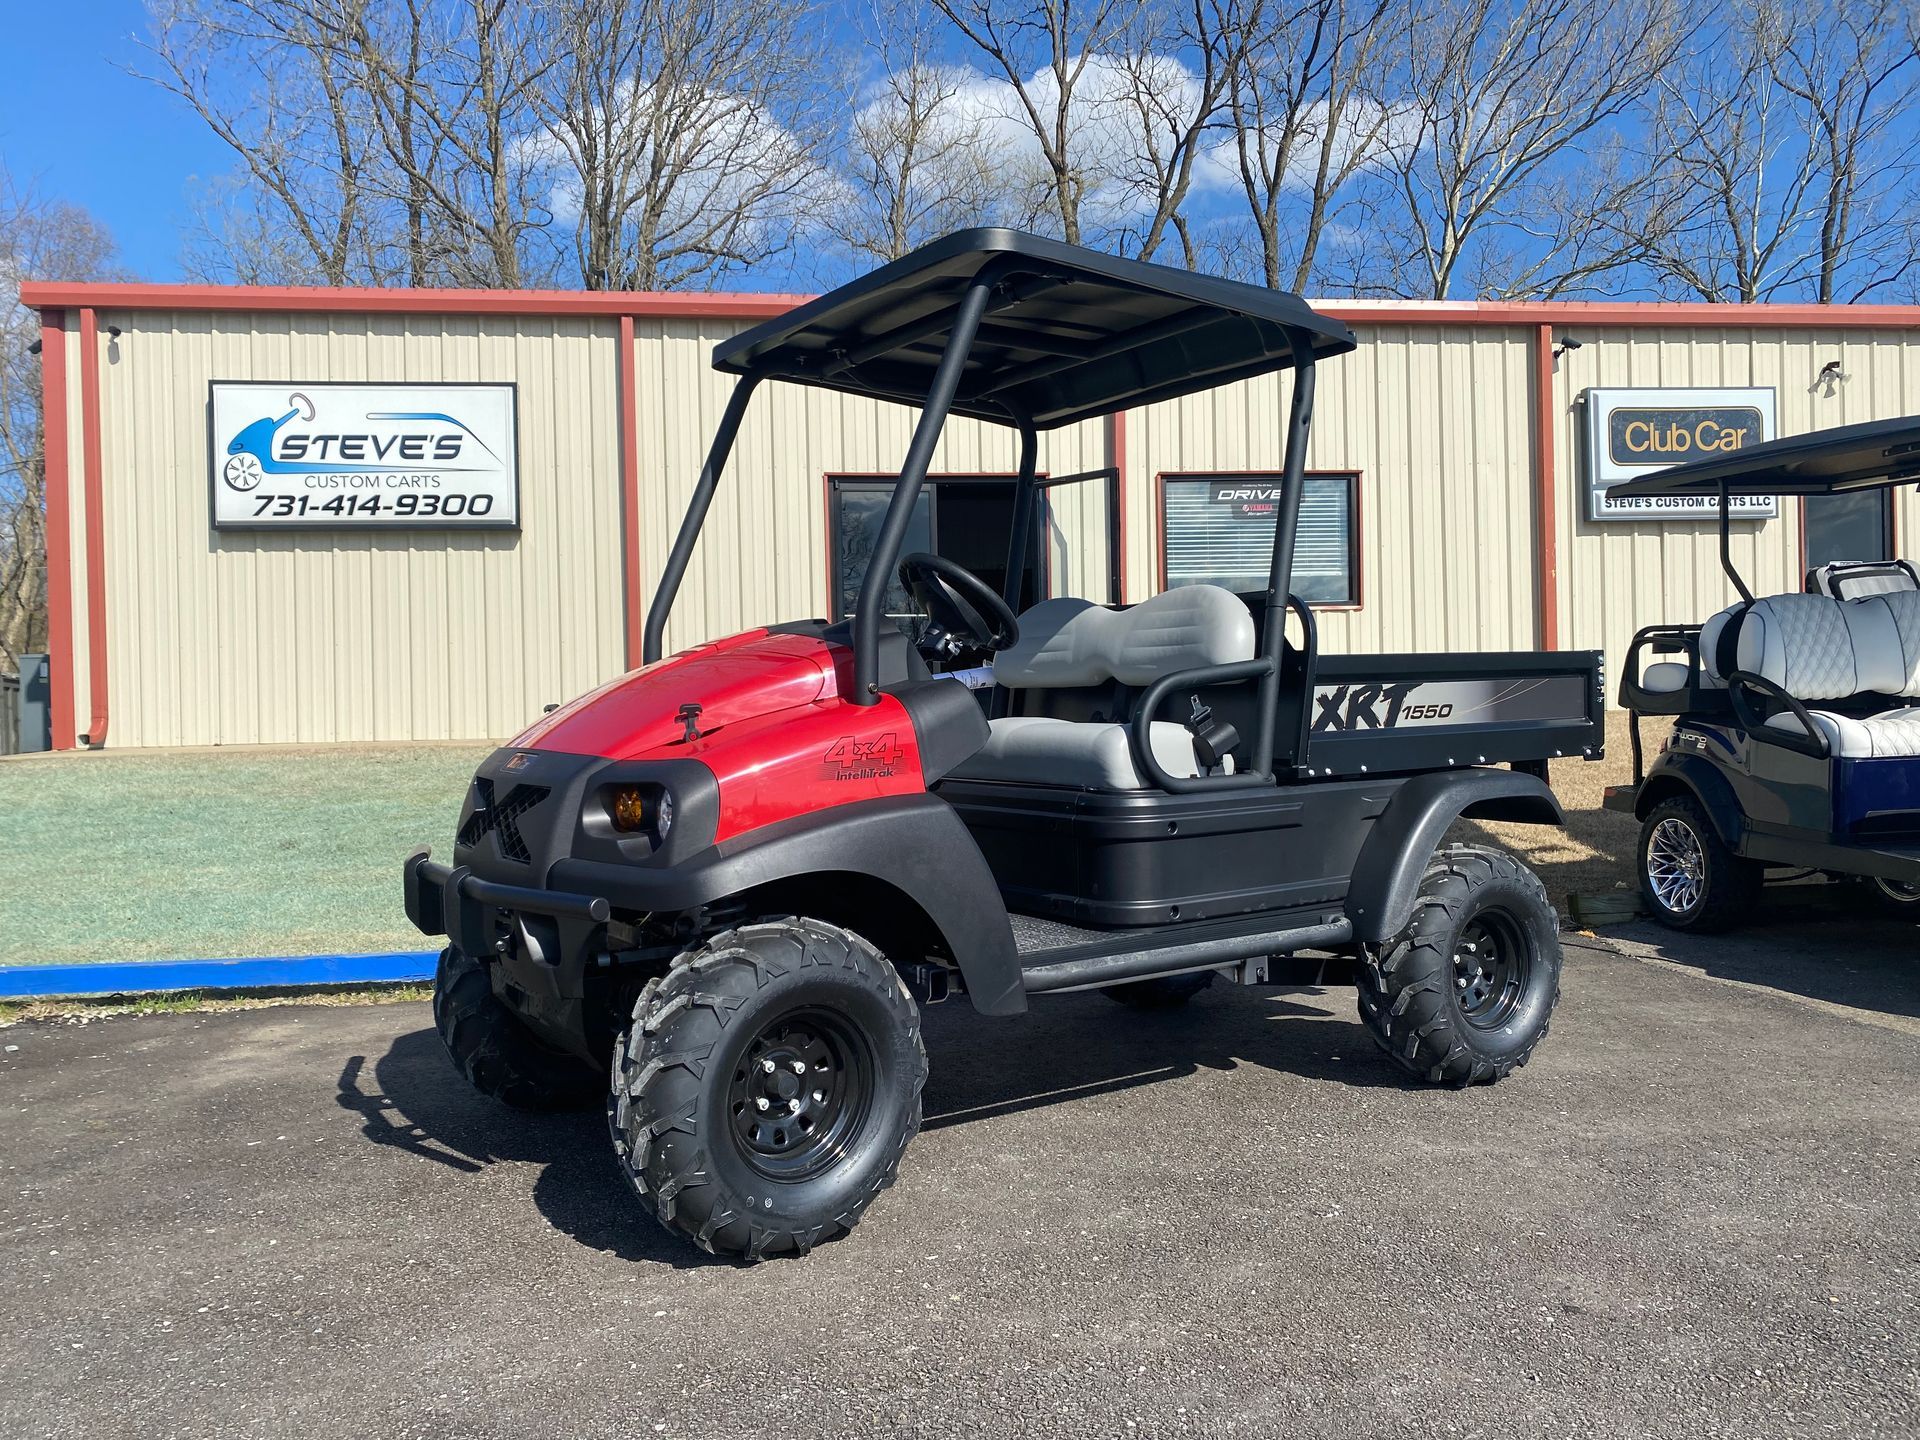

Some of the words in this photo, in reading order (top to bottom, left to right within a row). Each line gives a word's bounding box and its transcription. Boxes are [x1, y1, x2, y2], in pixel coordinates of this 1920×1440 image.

[279, 434, 463, 461] STEVE'S
[1625, 420, 1691, 452] Club
[1694, 420, 1747, 452] Car
[304, 475, 380, 489] CUSTOM
[385, 474, 441, 488] CARTS
[252, 494, 494, 517] 731-414-9300
[1217, 489, 1281, 500] DRIVE
[1604, 497, 1653, 508] STEVE'S
[1655, 497, 1705, 508] CUSTOM
[1749, 496, 1771, 507] LLC
[1311, 682, 1425, 731] XRT
[1401, 703, 1453, 720] 1550
[824, 732, 904, 769] 4x4
[835, 768, 894, 781] IntelliTrak
